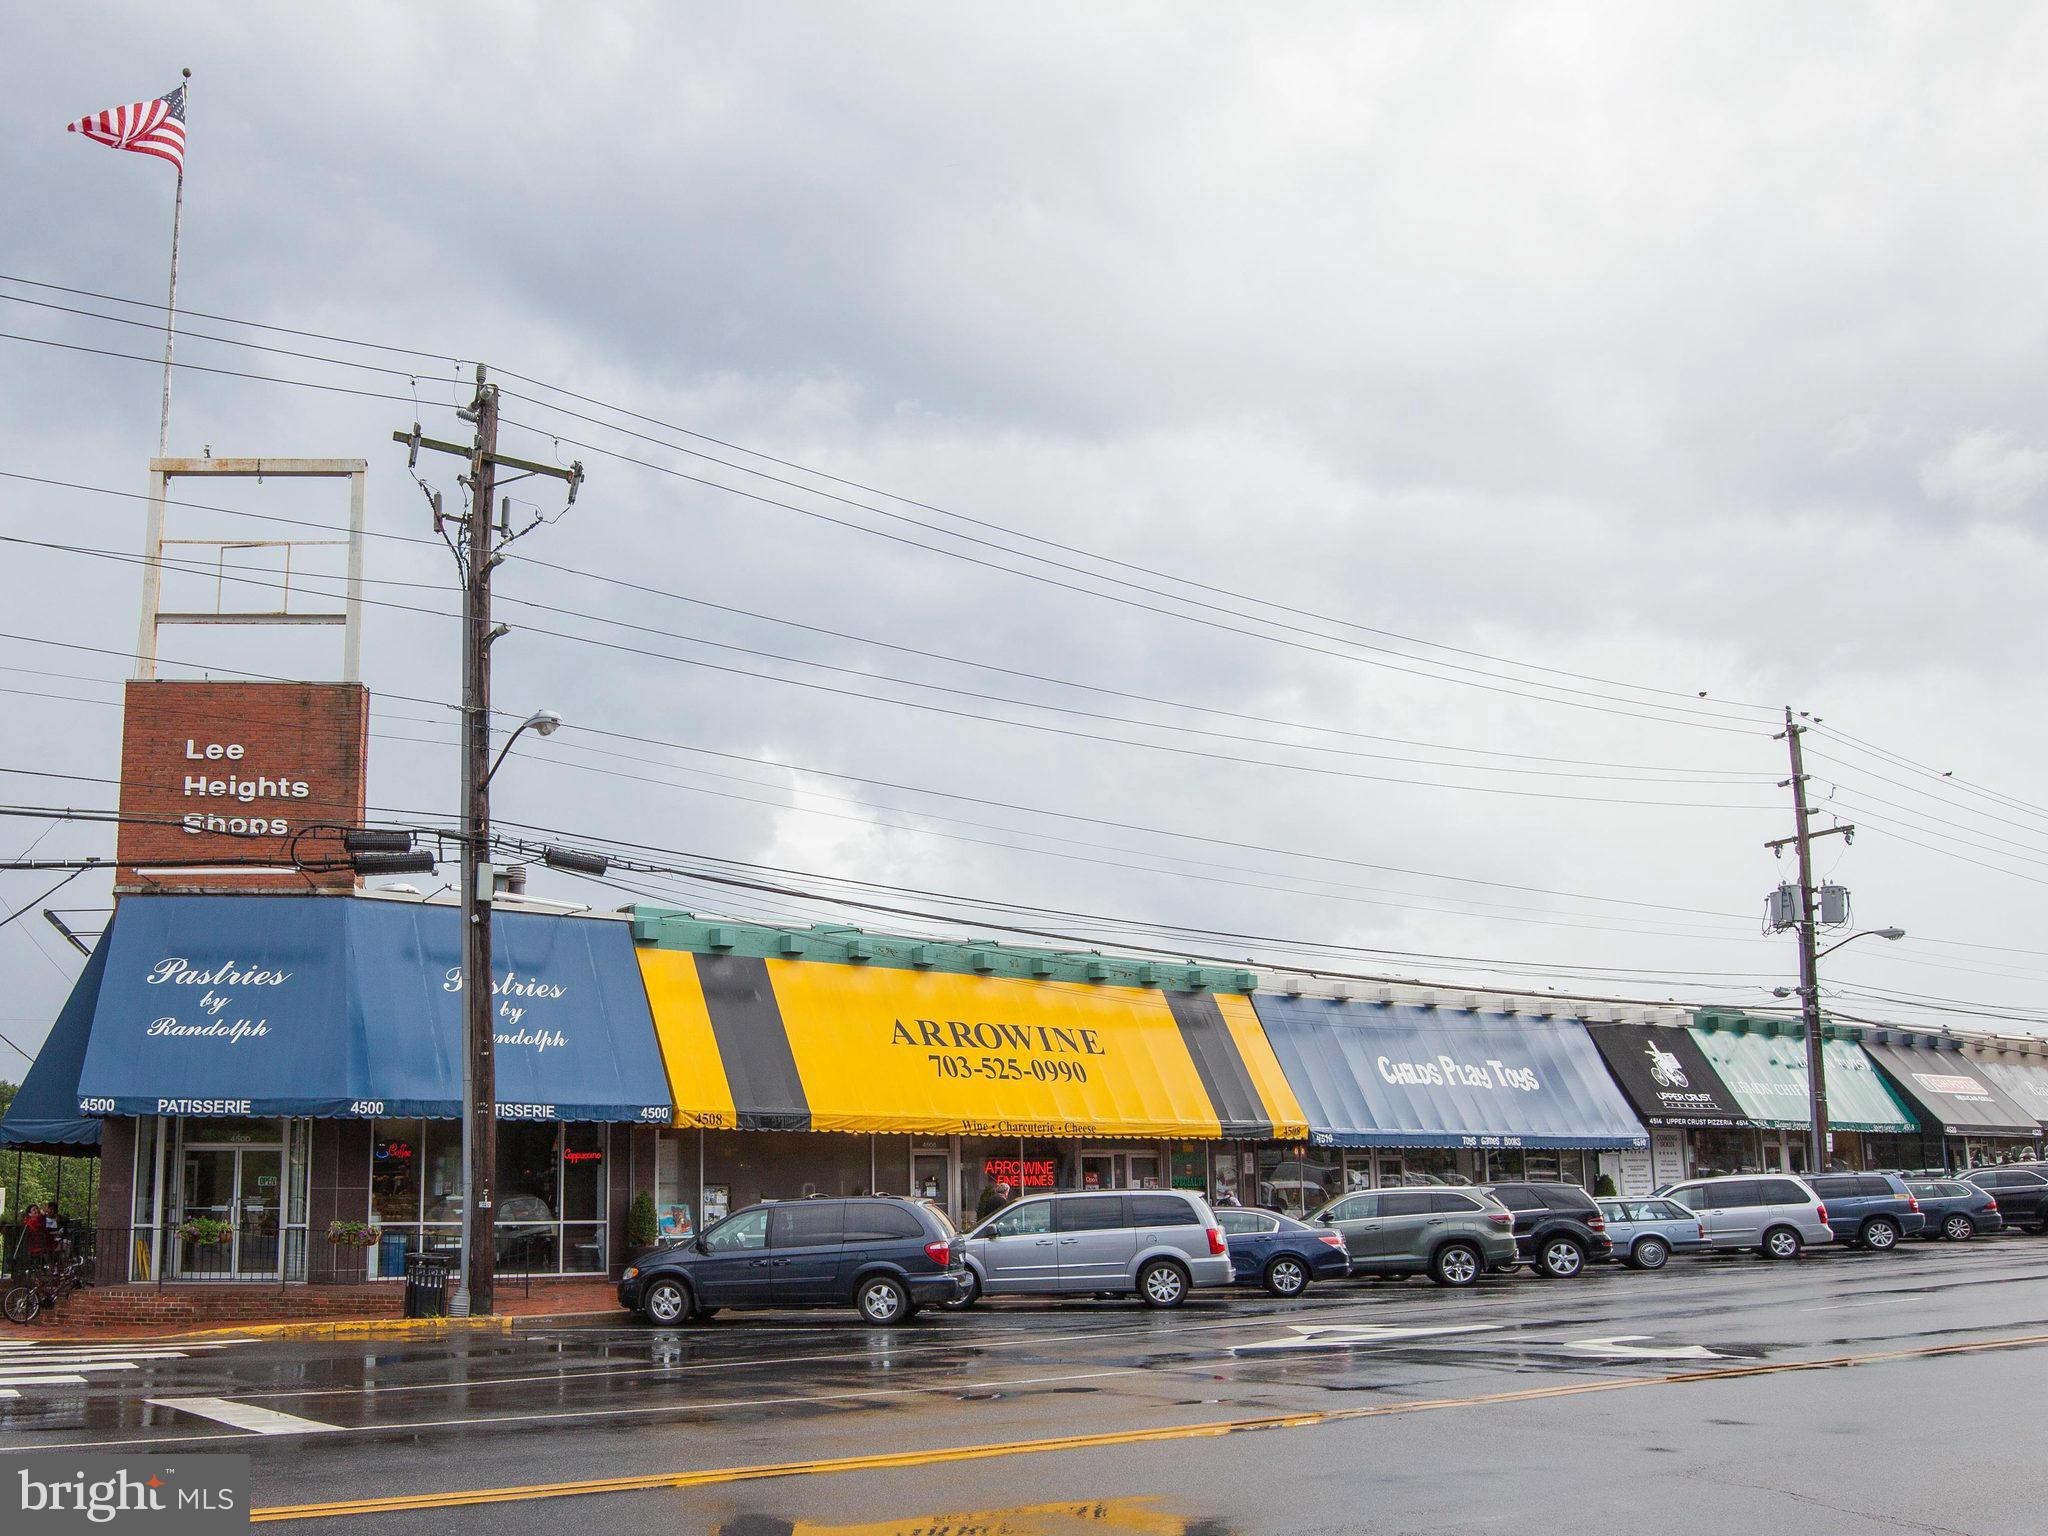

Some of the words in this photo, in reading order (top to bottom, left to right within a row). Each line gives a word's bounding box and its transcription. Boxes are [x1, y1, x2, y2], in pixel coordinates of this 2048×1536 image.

[186, 739, 245, 760] Lee
[184, 775, 309, 802] Heights
[183, 813, 289, 836] Shops
[146, 957, 293, 986] Pastries
[442, 967, 568, 999] Pstries
[199, 990, 232, 1015] by
[500, 1001, 527, 1025] by
[146, 1017, 272, 1044] Randolph
[492, 1028, 569, 1053] ndolph
[891, 1018, 1106, 1056] ARROWINE
[928, 1054, 1088, 1084] 703-525-0990
[79, 1098, 115, 1112] 4500
[157, 1099, 252, 1114] PATISSERIE
[1656, 1091, 1686, 1102] UPPER
[1685, 1093, 1712, 1102] CRUST
[350, 1101, 384, 1115] 4500
[495, 1103, 555, 1118] TISSERIE
[641, 1107, 669, 1119] 4500
[694, 1113, 723, 1126] 4508
[1666, 1117, 1687, 1125] UPPER
[1687, 1118, 1707, 1126] CRUST
[1707, 1118, 1734, 1126] PIZZERIA
[961, 1119, 989, 1131] Wine
[998, 1120, 1056, 1133] Charcuterie
[1064, 1122, 1097, 1134] Cheese
[259, 1176, 277, 1186] OPEN
[1022, 1174, 1055, 1187] WINES
